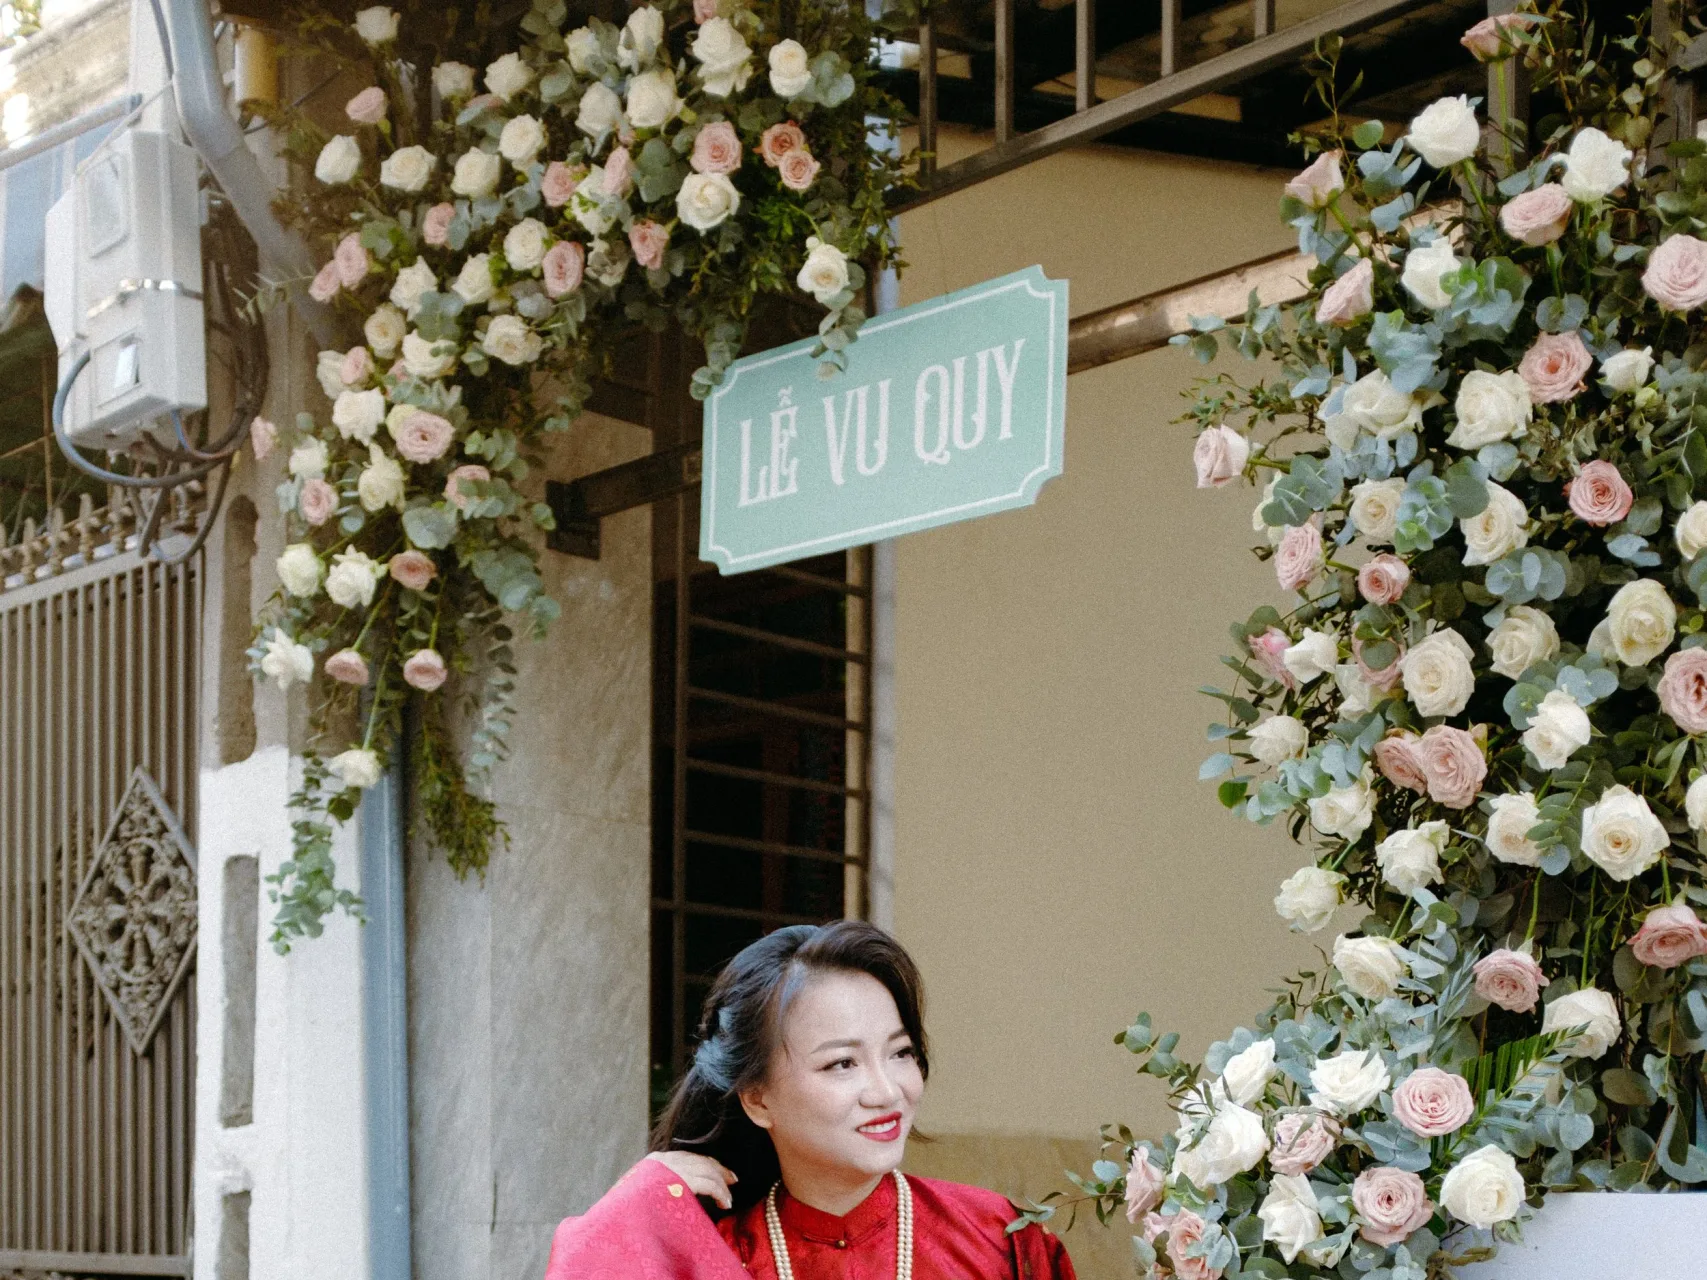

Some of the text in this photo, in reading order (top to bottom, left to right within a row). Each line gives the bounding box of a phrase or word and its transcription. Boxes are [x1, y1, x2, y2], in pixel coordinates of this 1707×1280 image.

[738, 338, 1026, 507] LỄ VU QUY
